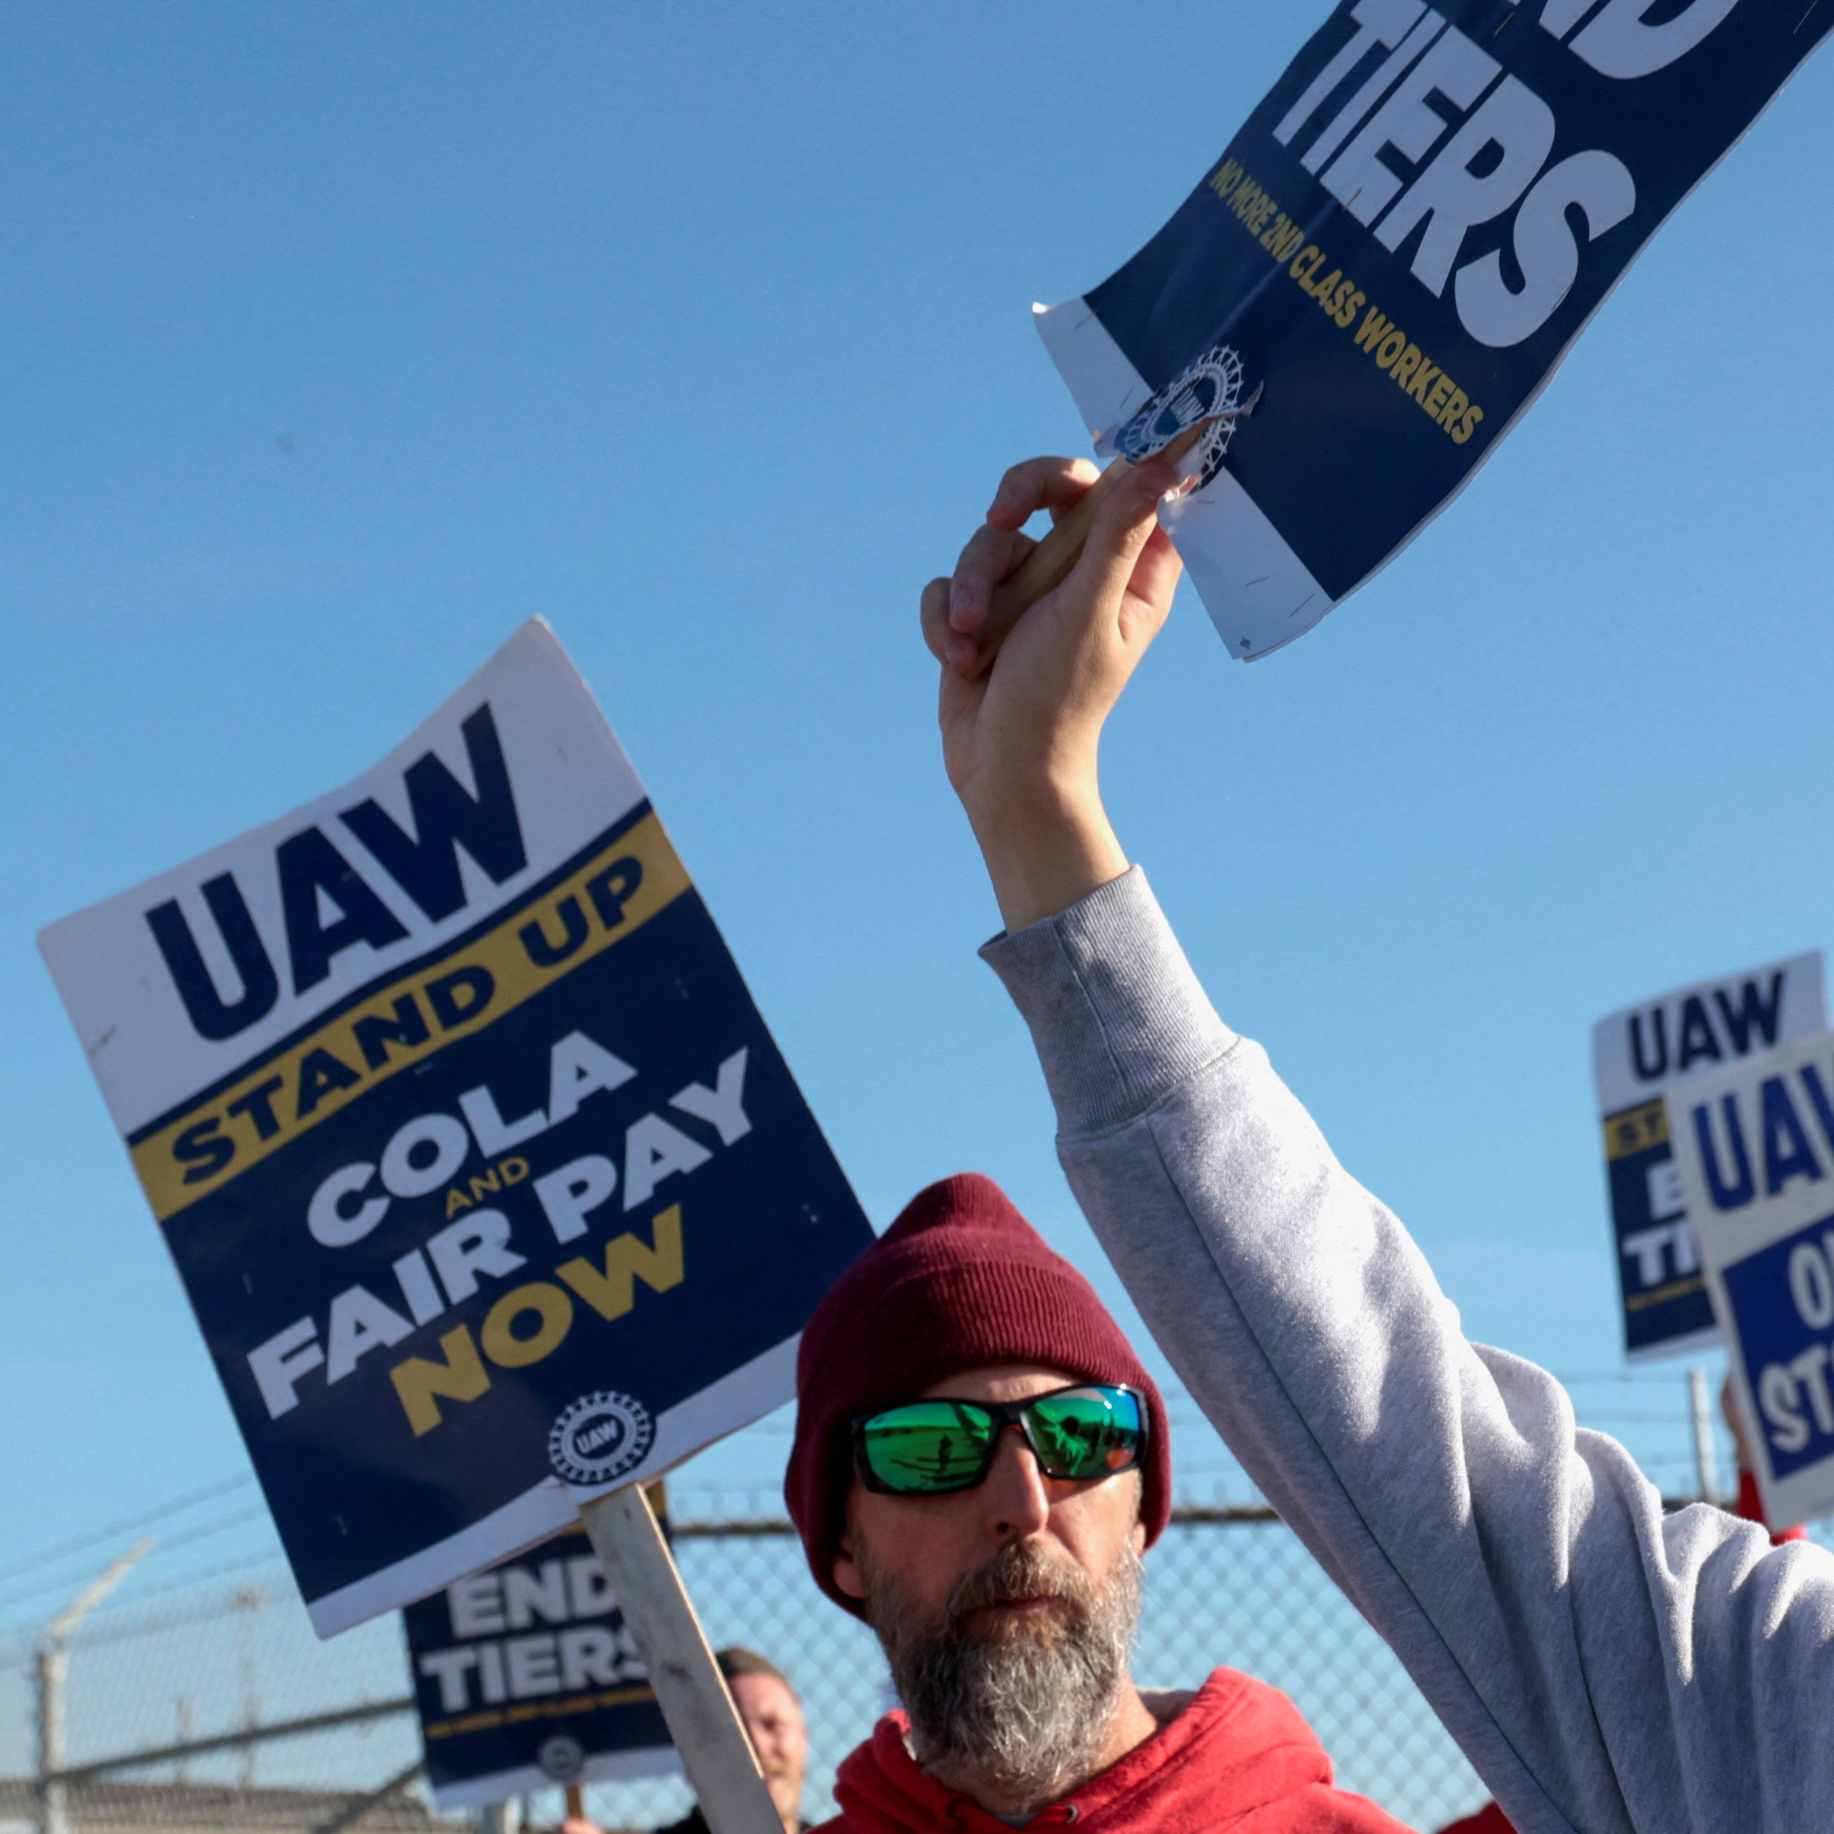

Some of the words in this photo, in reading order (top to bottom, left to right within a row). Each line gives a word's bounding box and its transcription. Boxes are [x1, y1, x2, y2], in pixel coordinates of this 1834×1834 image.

[1272, 0, 1637, 348] TIERS
[1209, 156, 1244, 199] NO
[1227, 174, 1278, 237] MORE
[1260, 212, 1306, 264] 2ND
[1289, 245, 1366, 328] CLASS
[1353, 304, 1484, 445] WORKERS
[143, 700, 528, 1044] UAW
[170, 964, 498, 1187] STAND
[517, 854, 645, 968] UP
[1627, 970, 1786, 1086] UAW
[247, 1208, 527, 1420] FAIR
[534, 1046, 753, 1244] PAY
[307, 1030, 638, 1249] COLA
[445, 1155, 530, 1220] AND
[389, 1203, 685, 1438] NOW
[575, 1418, 619, 1455] UAW
[447, 1556, 617, 1640] END
